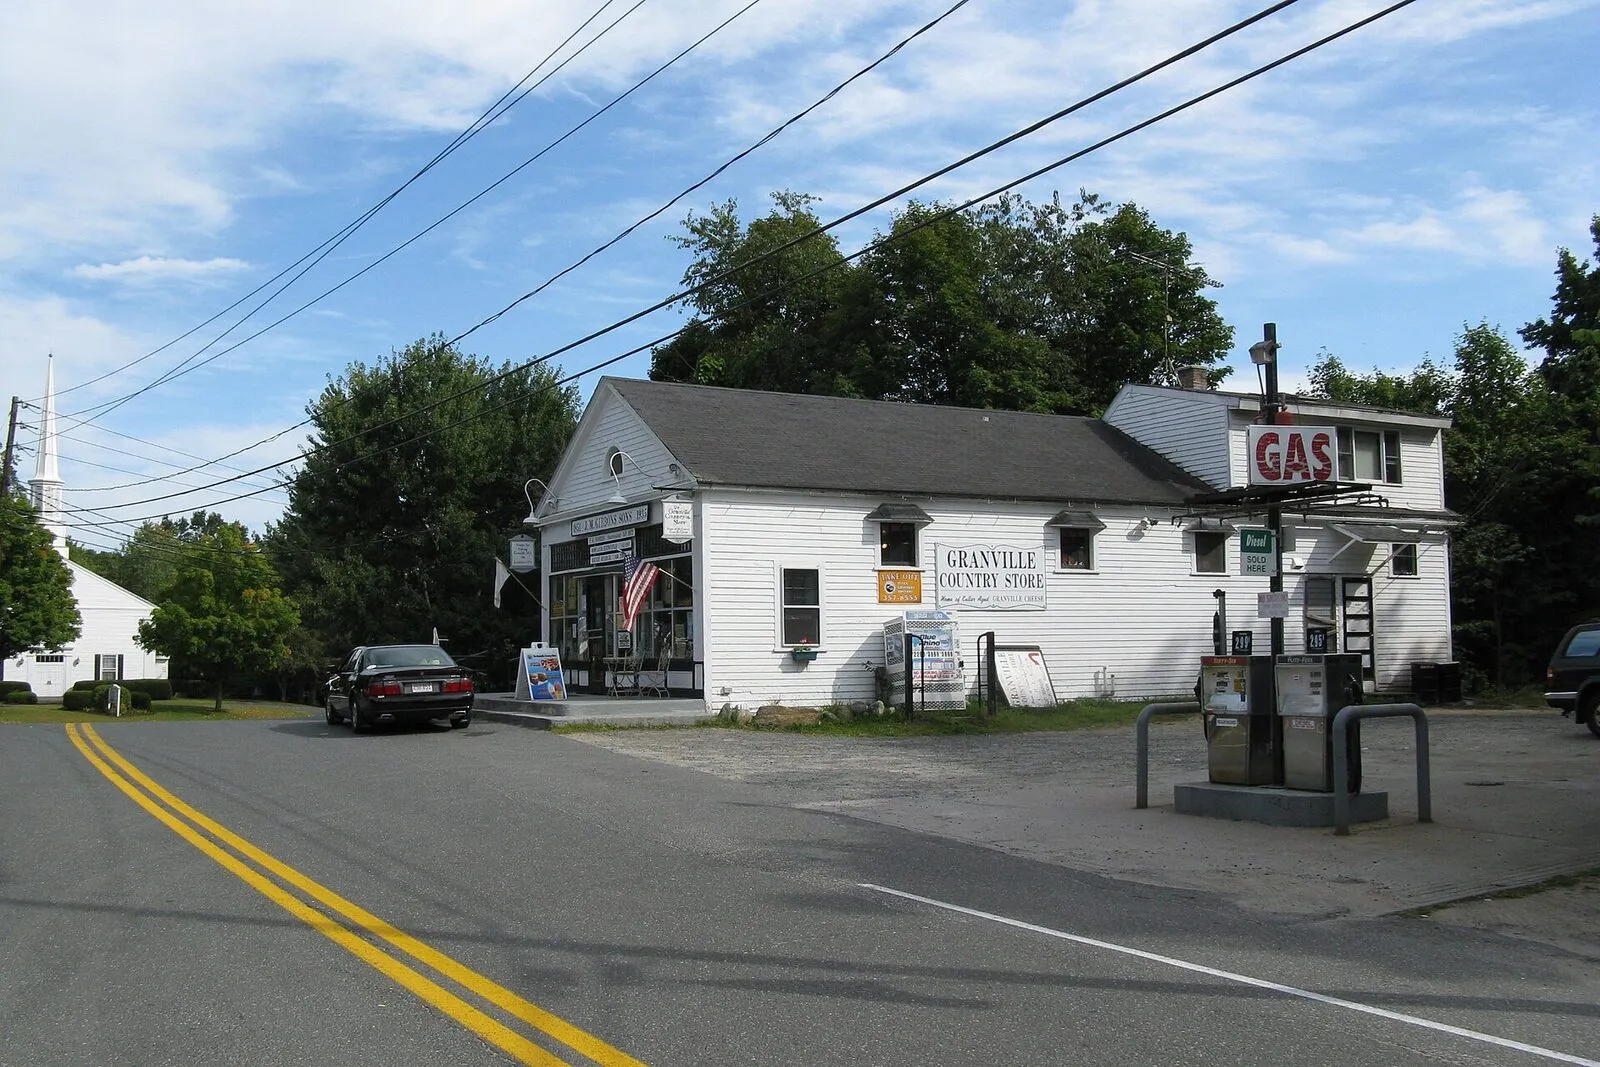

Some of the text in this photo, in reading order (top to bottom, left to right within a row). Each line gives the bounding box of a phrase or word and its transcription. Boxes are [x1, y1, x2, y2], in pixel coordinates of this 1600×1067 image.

[1256, 432, 1332, 481] GAS
[1246, 534, 1267, 547] Diesel
[947, 549, 1036, 569] GRANVILLE
[1247, 555, 1266, 564] SOLD
[1247, 564, 1266, 573] HERE
[881, 573, 900, 581] TAKE
[939, 572, 1044, 589] COUNTRY STORE
[955, 595, 961, 603] of
[992, 595, 1022, 603] GRANVILLE
